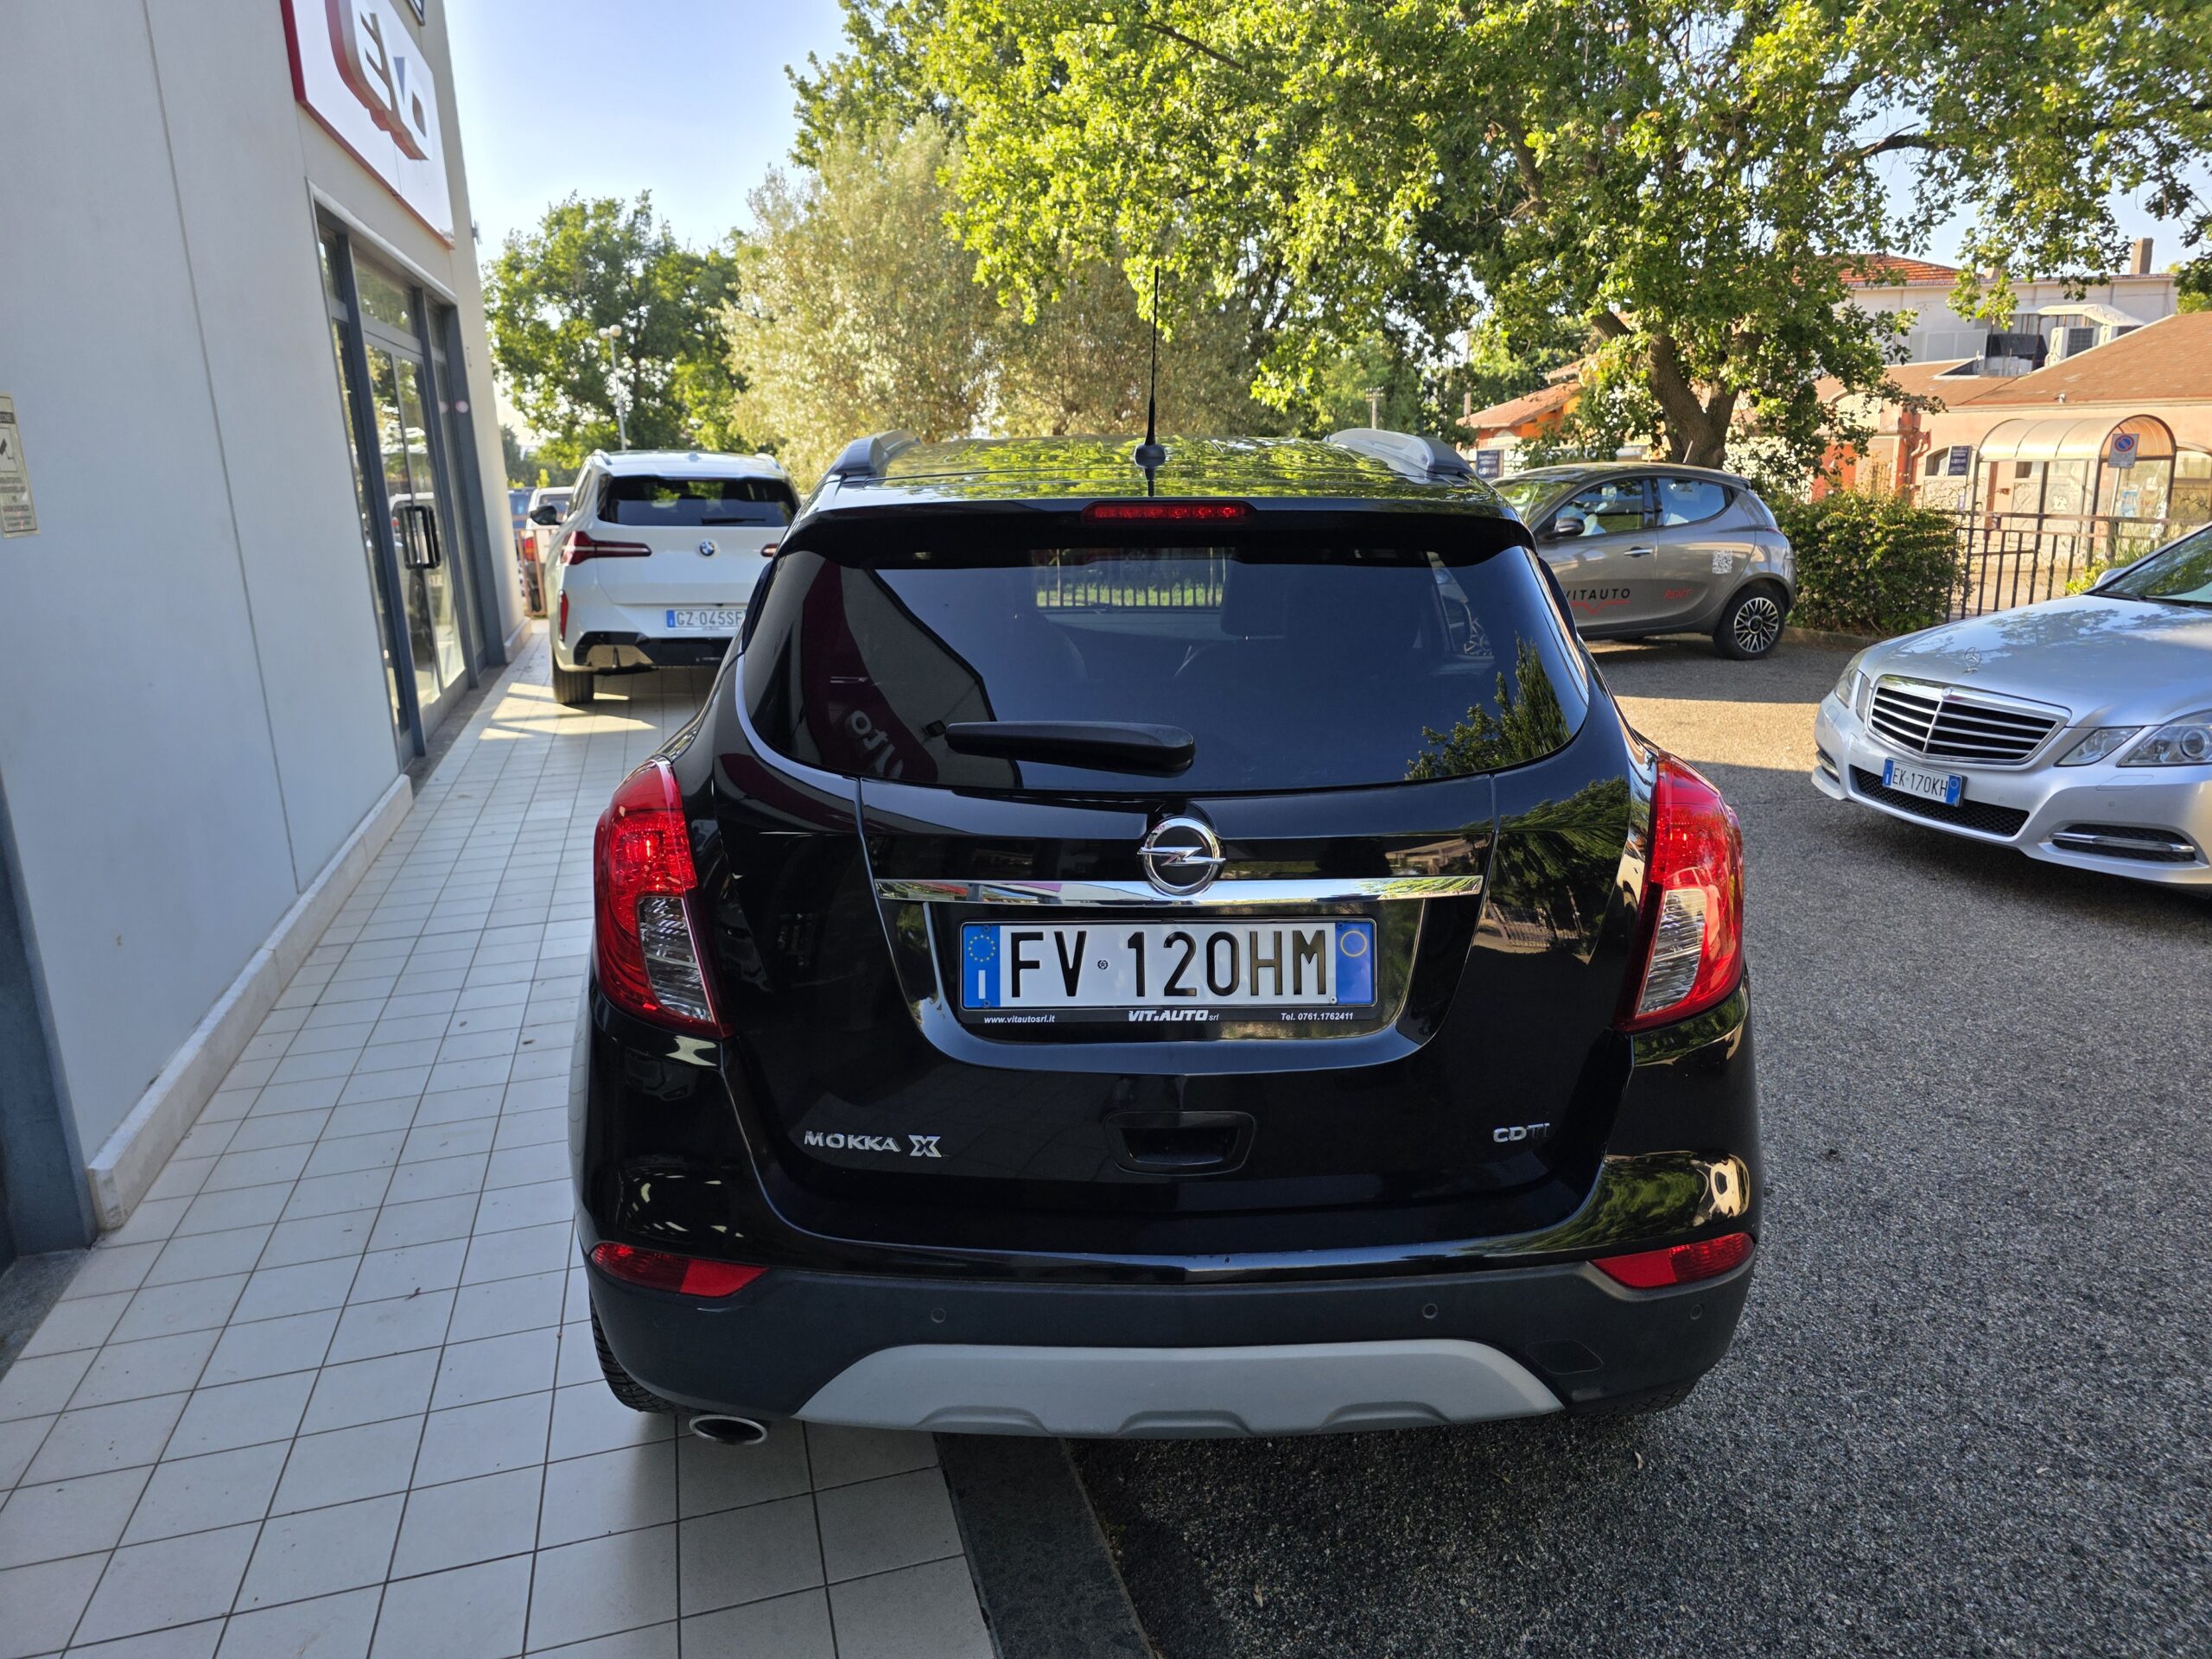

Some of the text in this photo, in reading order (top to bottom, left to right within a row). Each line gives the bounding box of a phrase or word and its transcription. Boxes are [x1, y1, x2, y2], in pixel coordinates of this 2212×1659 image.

[1664, 588, 1693, 601] RENT
[677, 612, 694, 626] GZ
[1892, 767, 1906, 787] EK
[1911, 772, 1948, 798] 170KH
[1010, 931, 1087, 998] FV
[1128, 930, 1326, 997] 120HM
[984, 1014, 1056, 1024] www.vitautosrl.it
[1209, 1013, 1219, 1021] srl
[1281, 1012, 1354, 1021] Tel. 0761.1762411
[804, 1129, 942, 1158] MOKKA X
